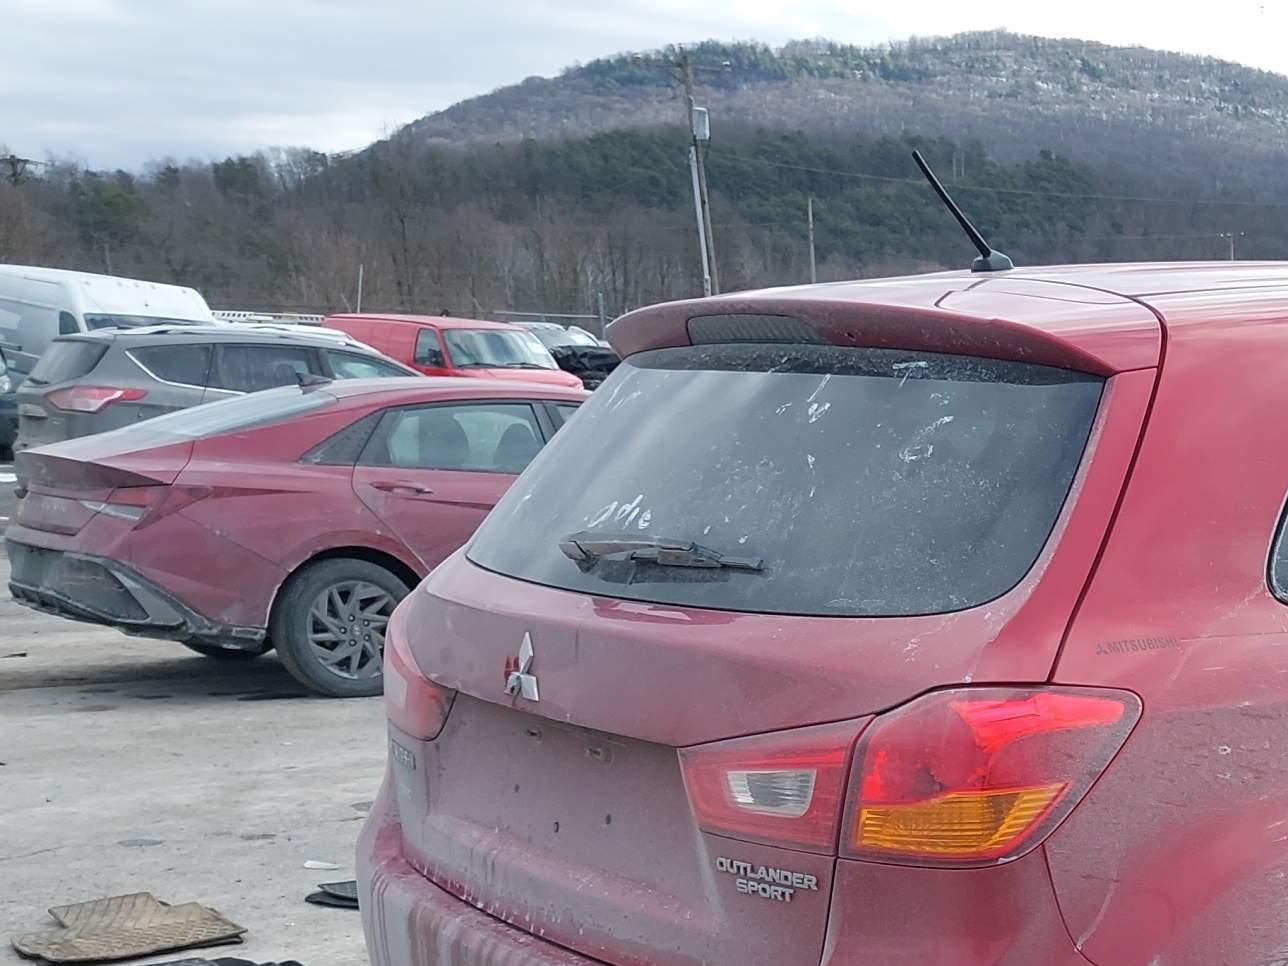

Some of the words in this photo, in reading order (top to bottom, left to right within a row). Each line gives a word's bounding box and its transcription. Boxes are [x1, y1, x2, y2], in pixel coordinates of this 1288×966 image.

[1107, 636, 1177, 653] MITSUBISHI
[716, 857, 818, 890] OUTLANDER
[736, 878, 793, 901] SPORT
